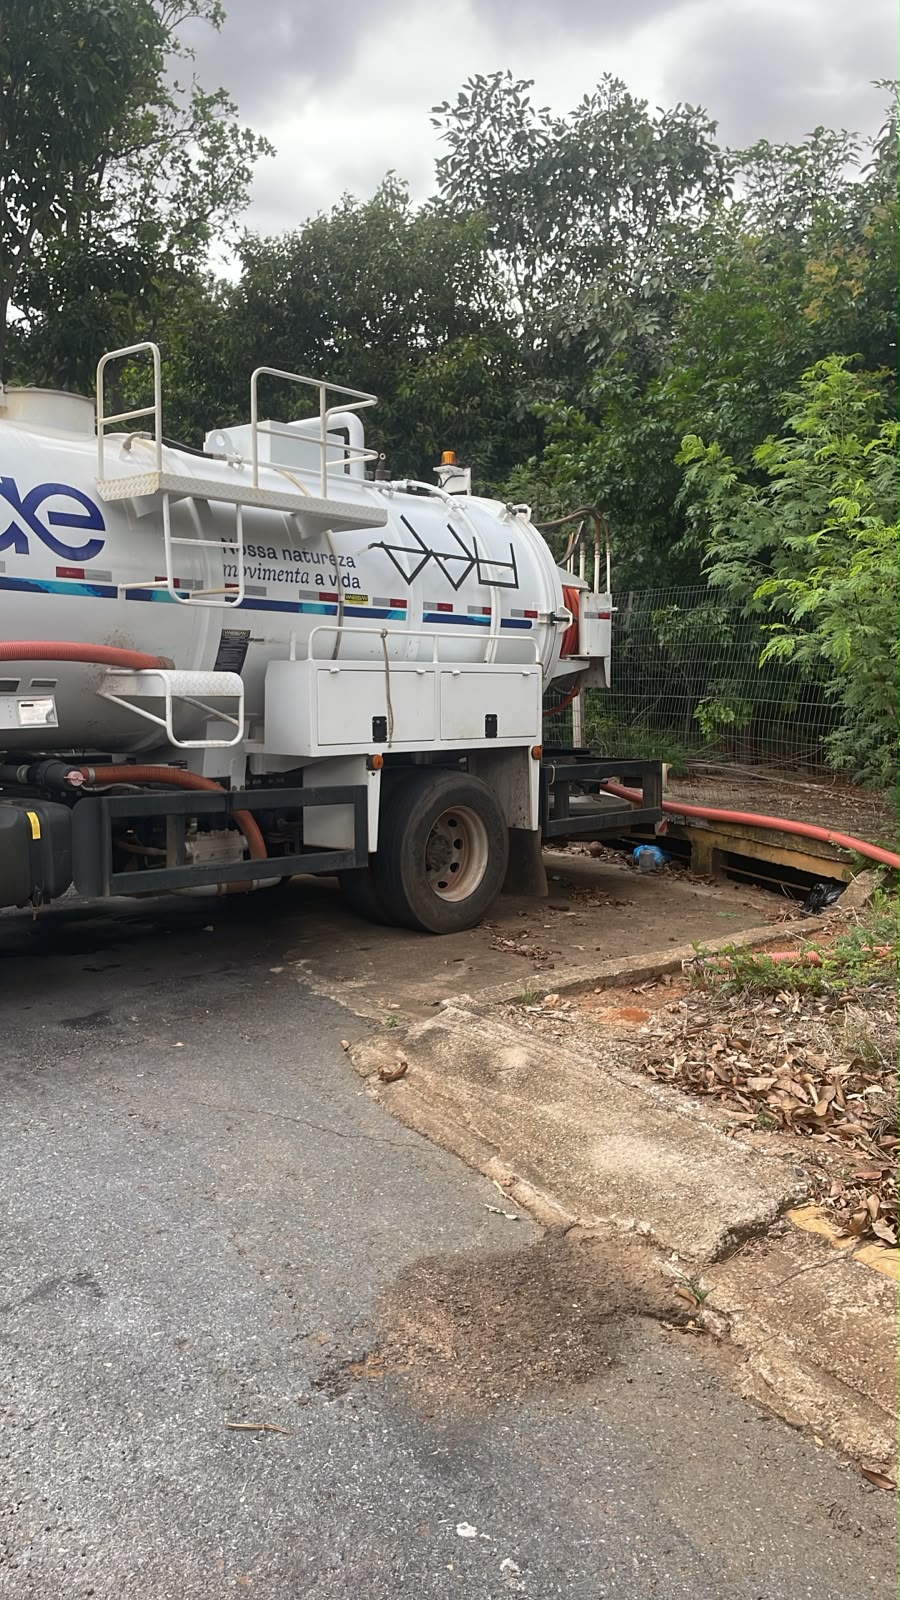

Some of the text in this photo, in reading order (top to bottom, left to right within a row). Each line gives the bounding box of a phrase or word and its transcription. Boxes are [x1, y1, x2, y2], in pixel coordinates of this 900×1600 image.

[282, 547, 356, 568] natureza
[315, 573, 325, 586] a
[329, 572, 361, 589] vda
